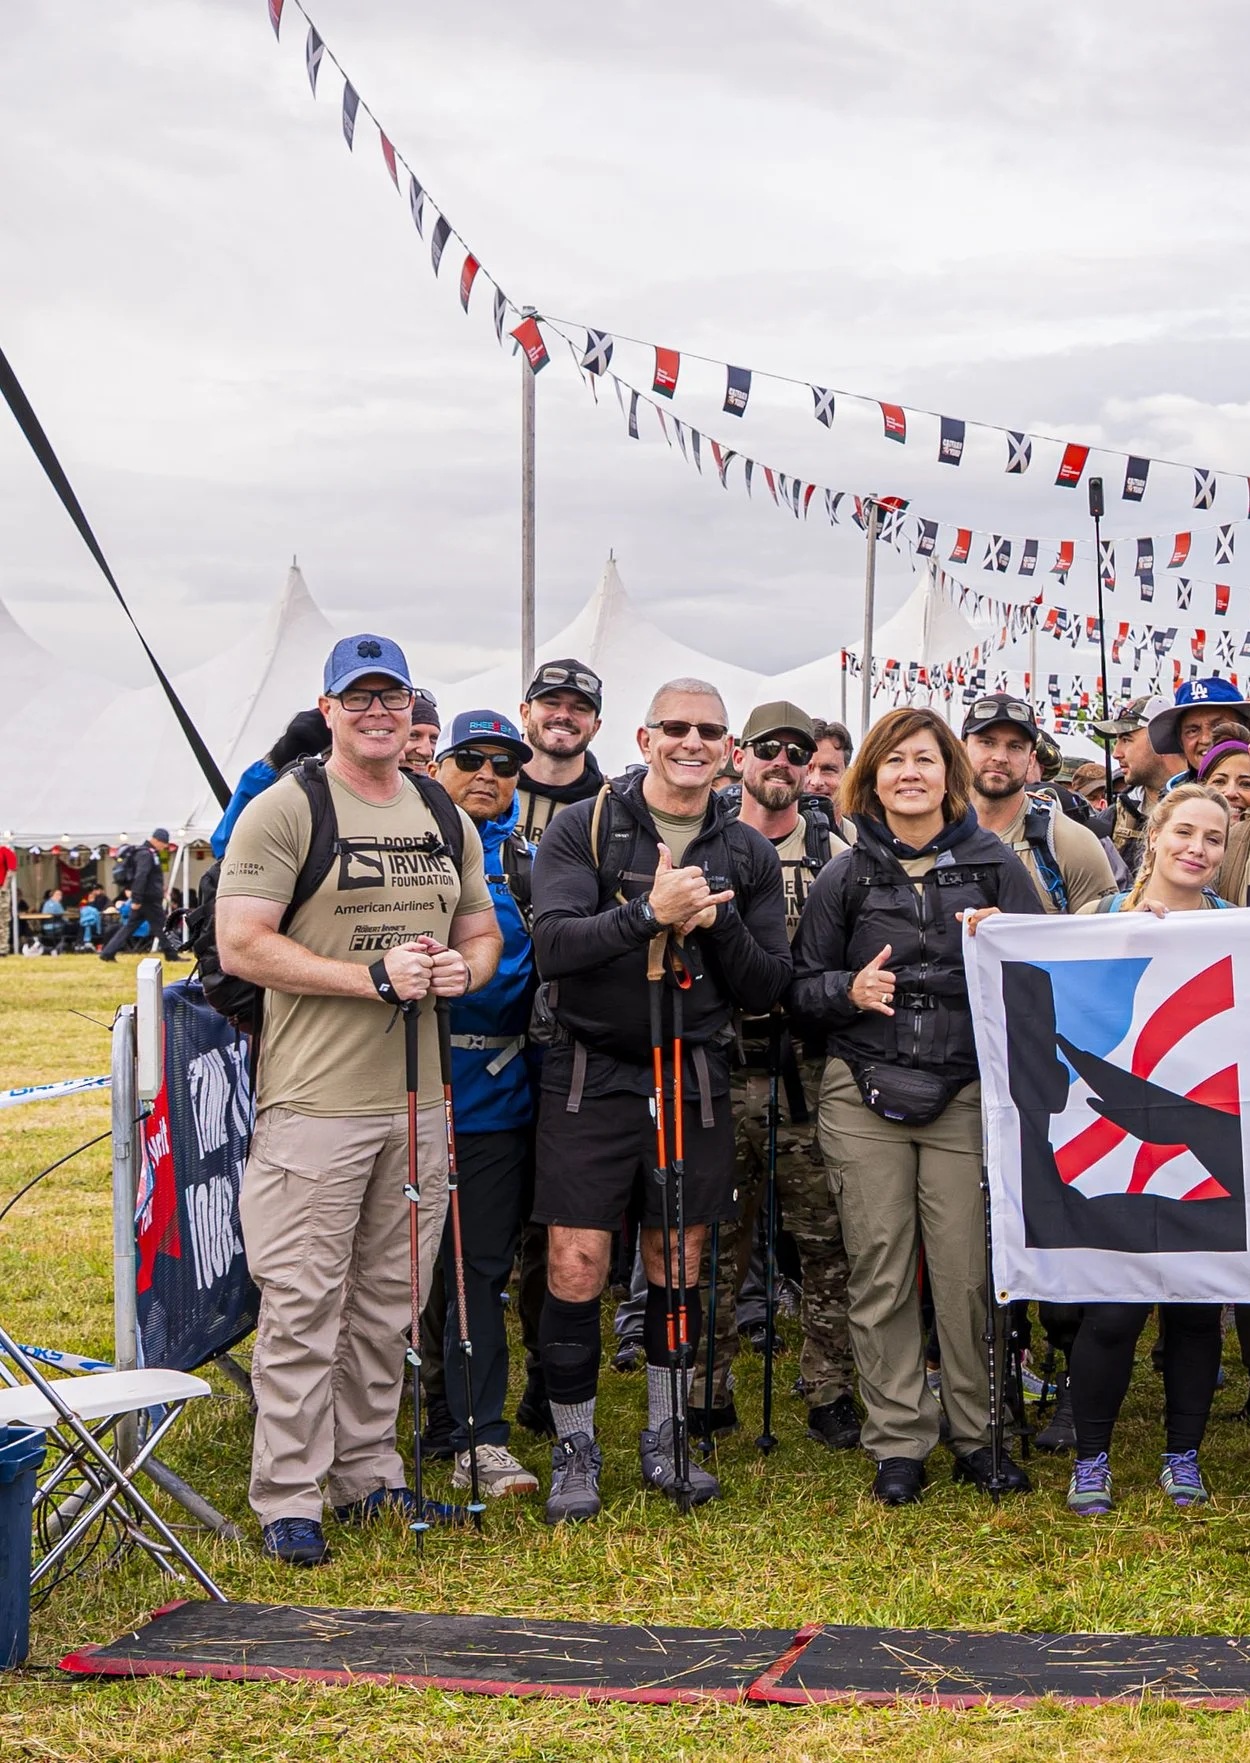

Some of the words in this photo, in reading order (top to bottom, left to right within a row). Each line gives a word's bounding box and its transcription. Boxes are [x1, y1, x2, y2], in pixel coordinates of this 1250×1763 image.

[1190, 681, 1208, 700] LA
[388, 854, 451, 874] IRVINE
[391, 875, 454, 887] FOUNDATION
[334, 902, 392, 915] American
[393, 901, 434, 912] Airlines
